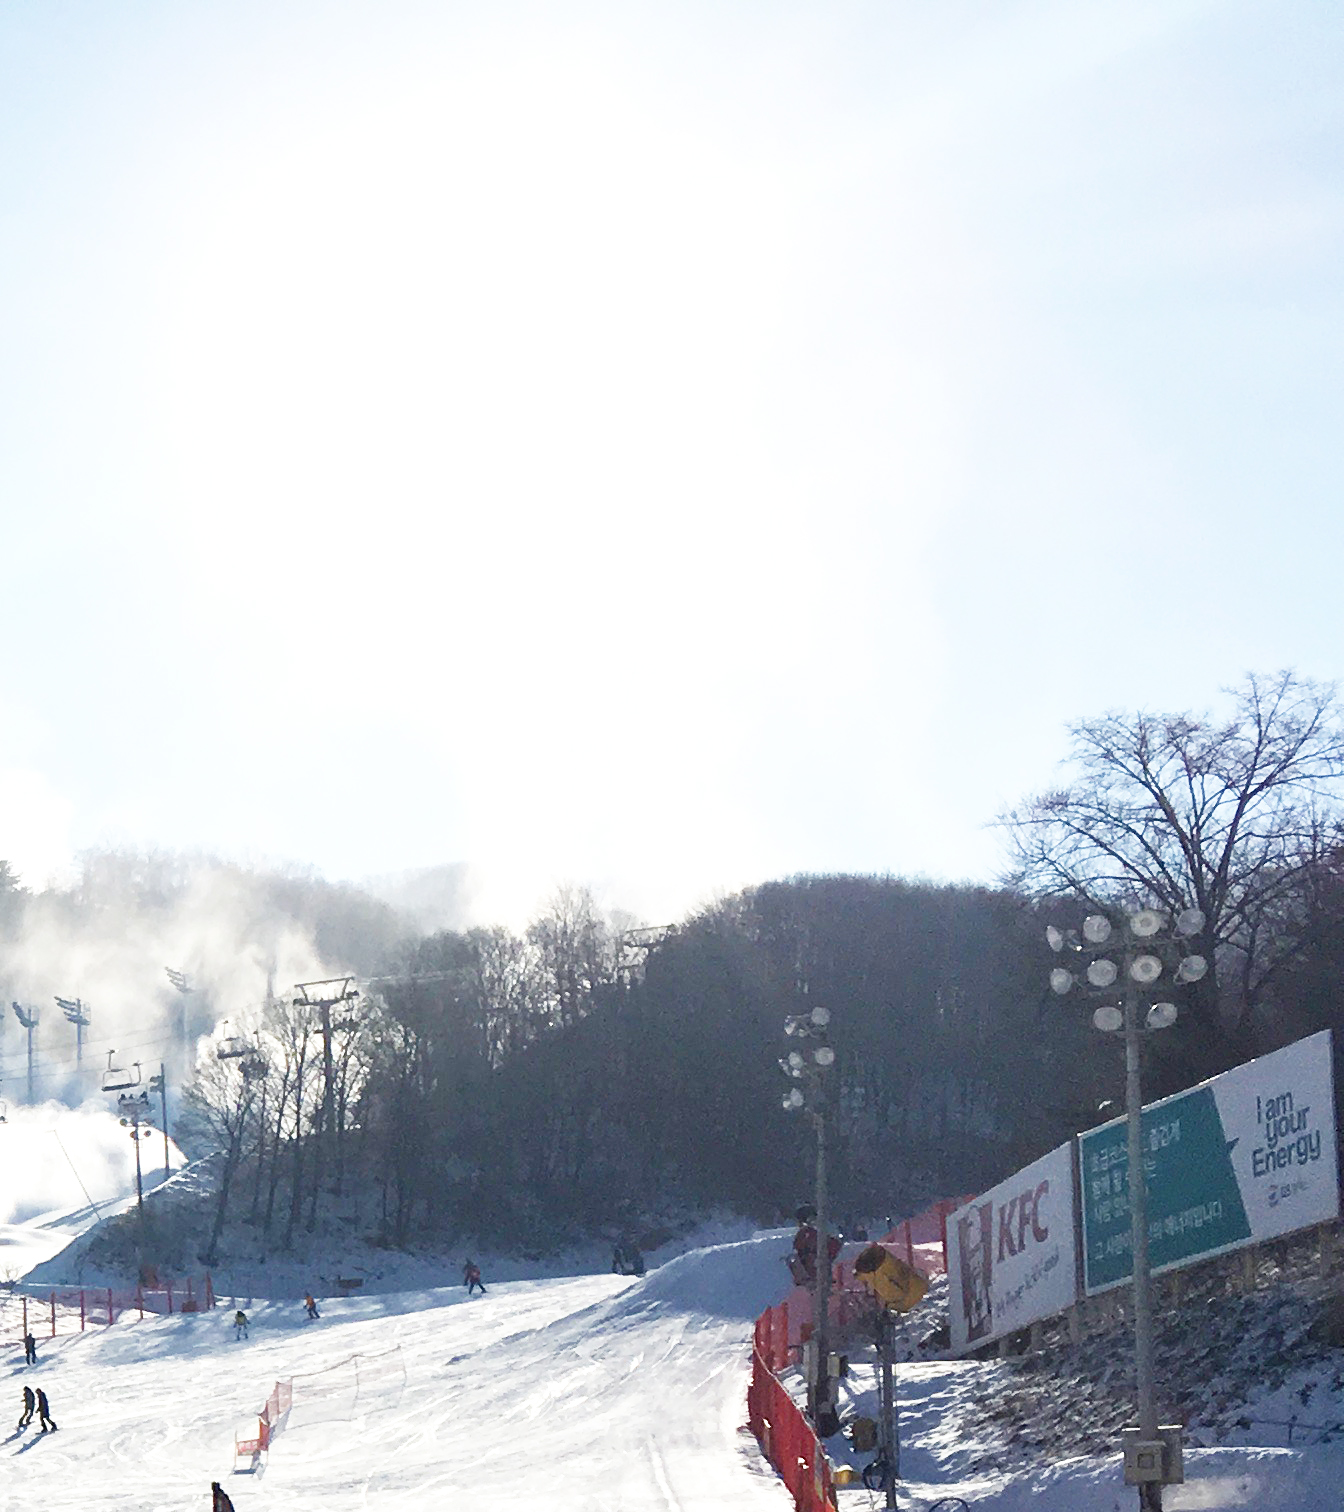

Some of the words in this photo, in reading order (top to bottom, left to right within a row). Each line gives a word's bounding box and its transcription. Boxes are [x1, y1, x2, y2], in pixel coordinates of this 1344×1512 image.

[1256, 1095, 1262, 1124] I
[1265, 1091, 1294, 1121] am
[1265, 1106, 1311, 1150] your
[1251, 1129, 1321, 1178] Energy
[996, 1179, 1050, 1264] KFC
